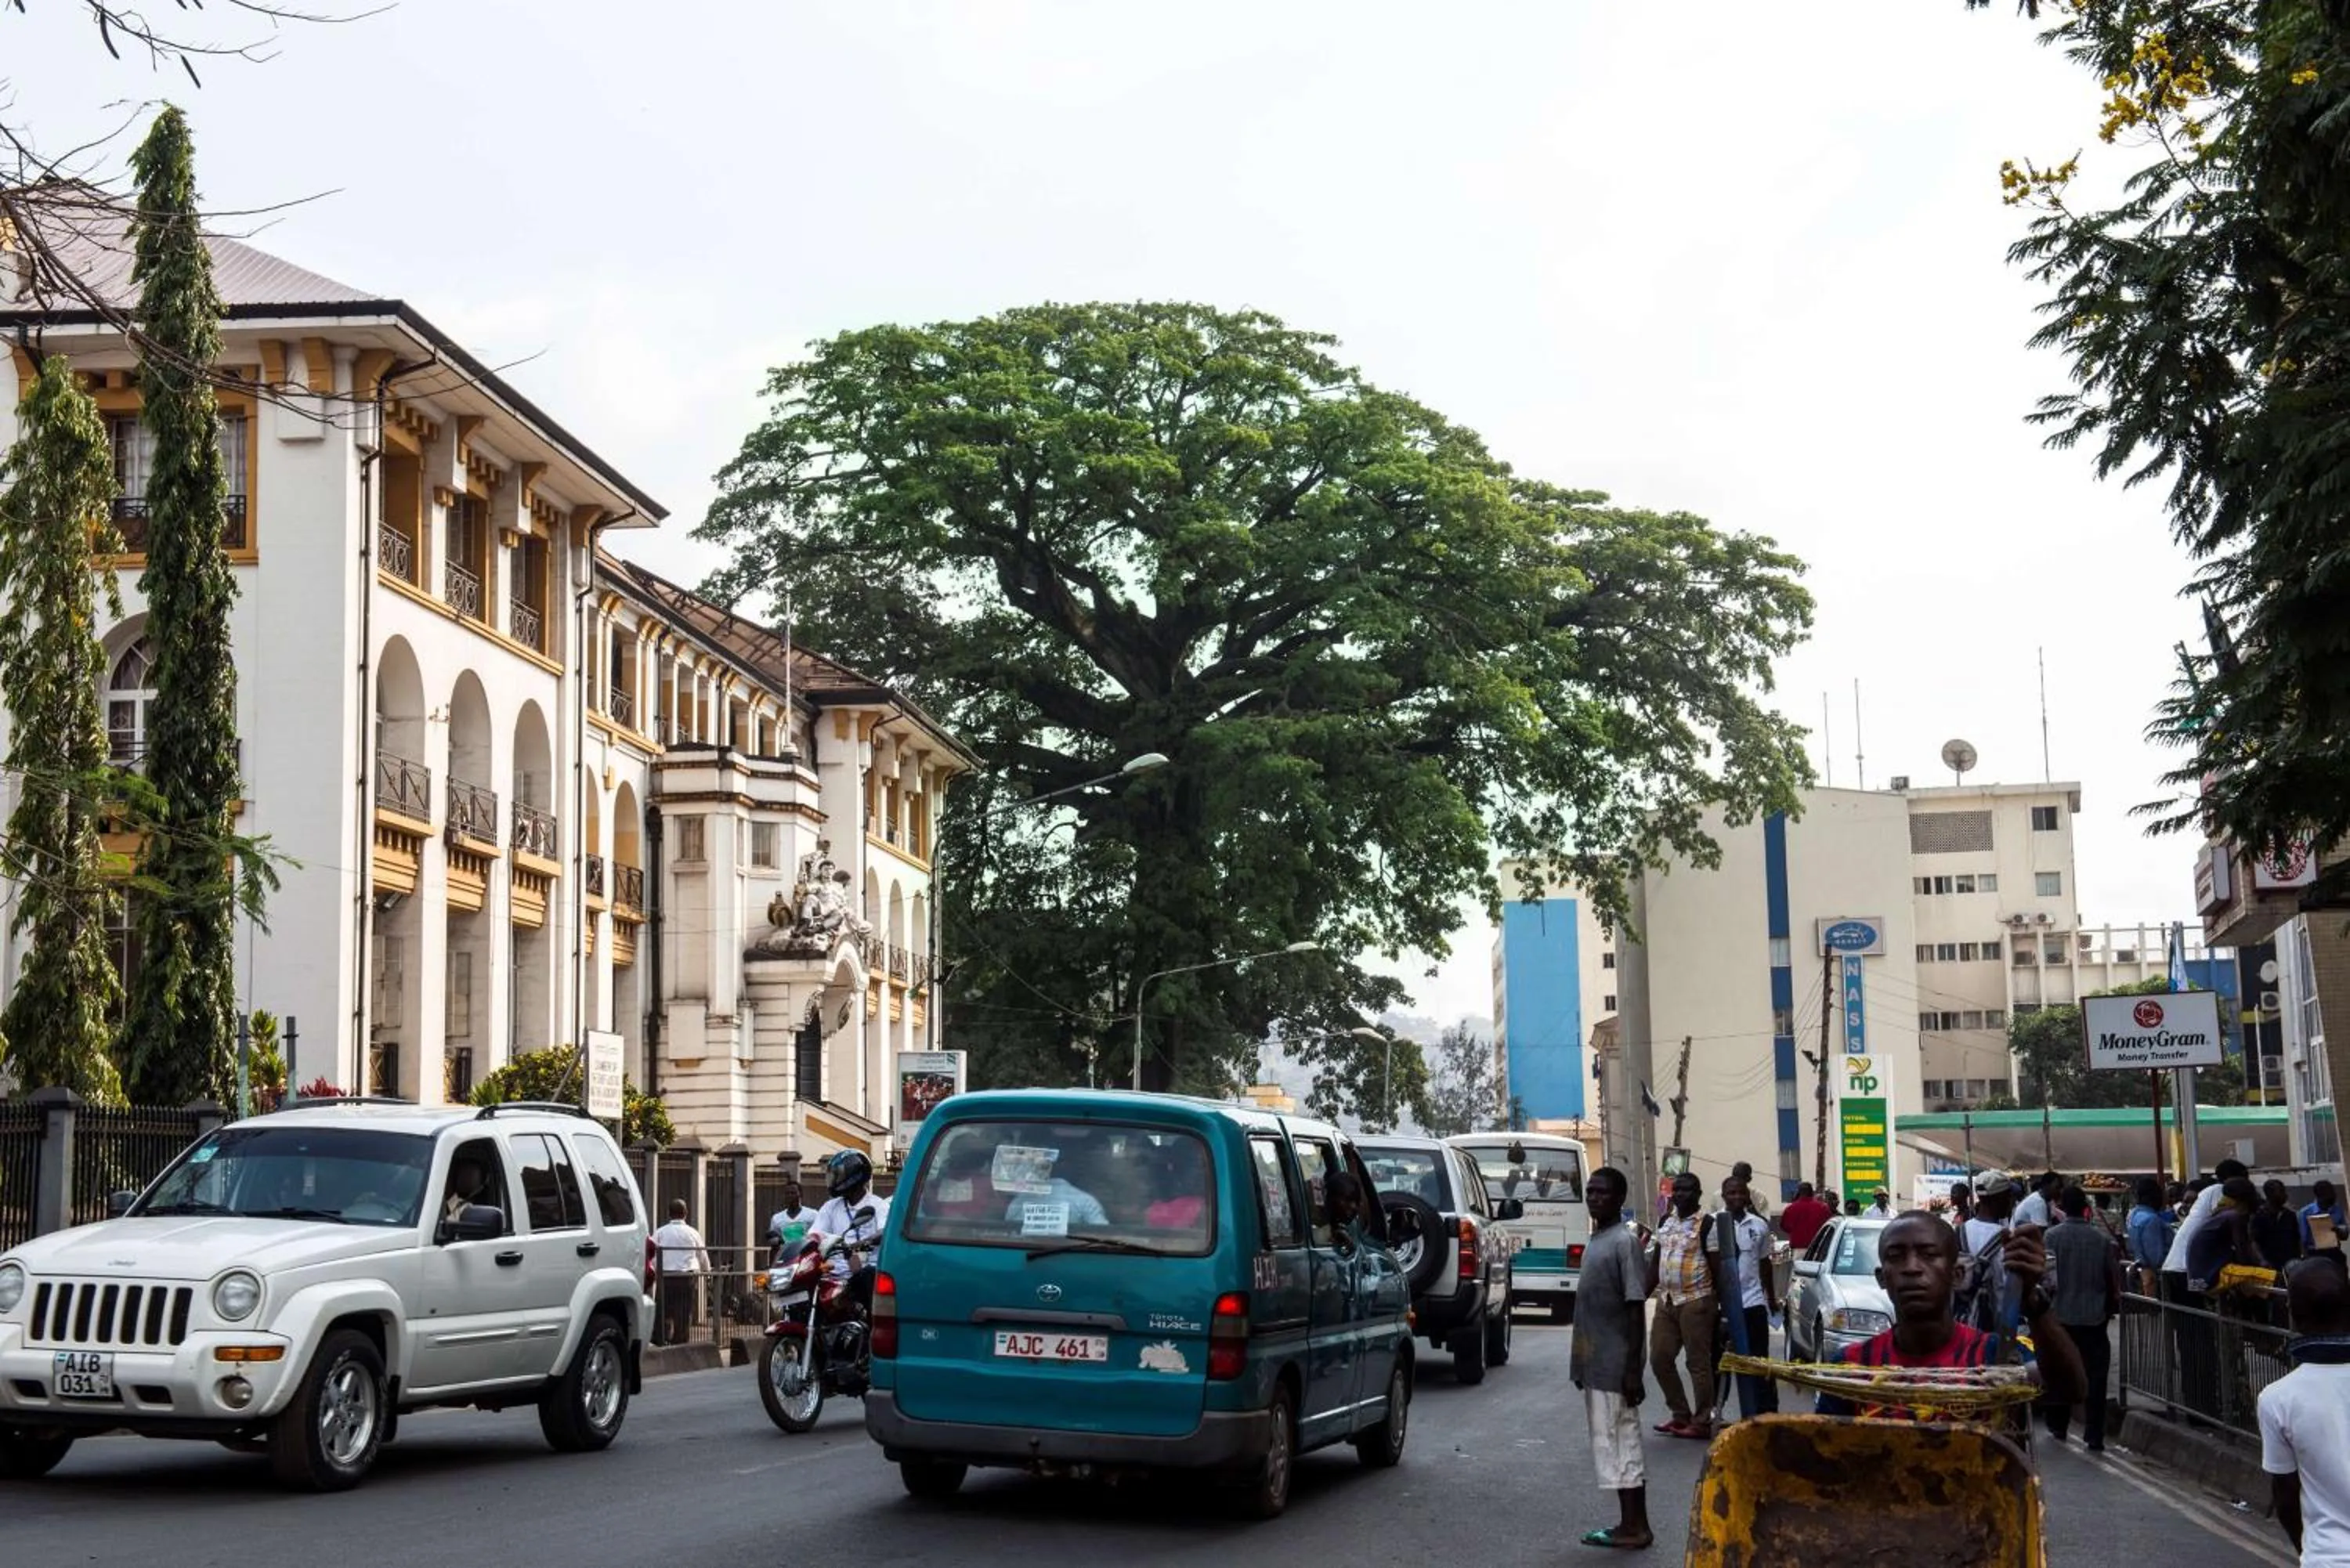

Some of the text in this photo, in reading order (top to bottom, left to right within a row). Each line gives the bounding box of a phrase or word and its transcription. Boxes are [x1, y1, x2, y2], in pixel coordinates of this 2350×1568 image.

[2099, 1030, 2206, 1050] MoneyGram
[2117, 1050, 2189, 1062] Money Transfer
[1849, 1075, 1878, 1095] np
[1148, 1313, 1184, 1321] TOYOTA
[1148, 1321, 1202, 1331] HIACE
[1006, 1334, 1044, 1356] AJC
[1054, 1338, 1090, 1359] 461
[64, 1353, 101, 1373] AIB
[60, 1375, 96, 1393] 031
